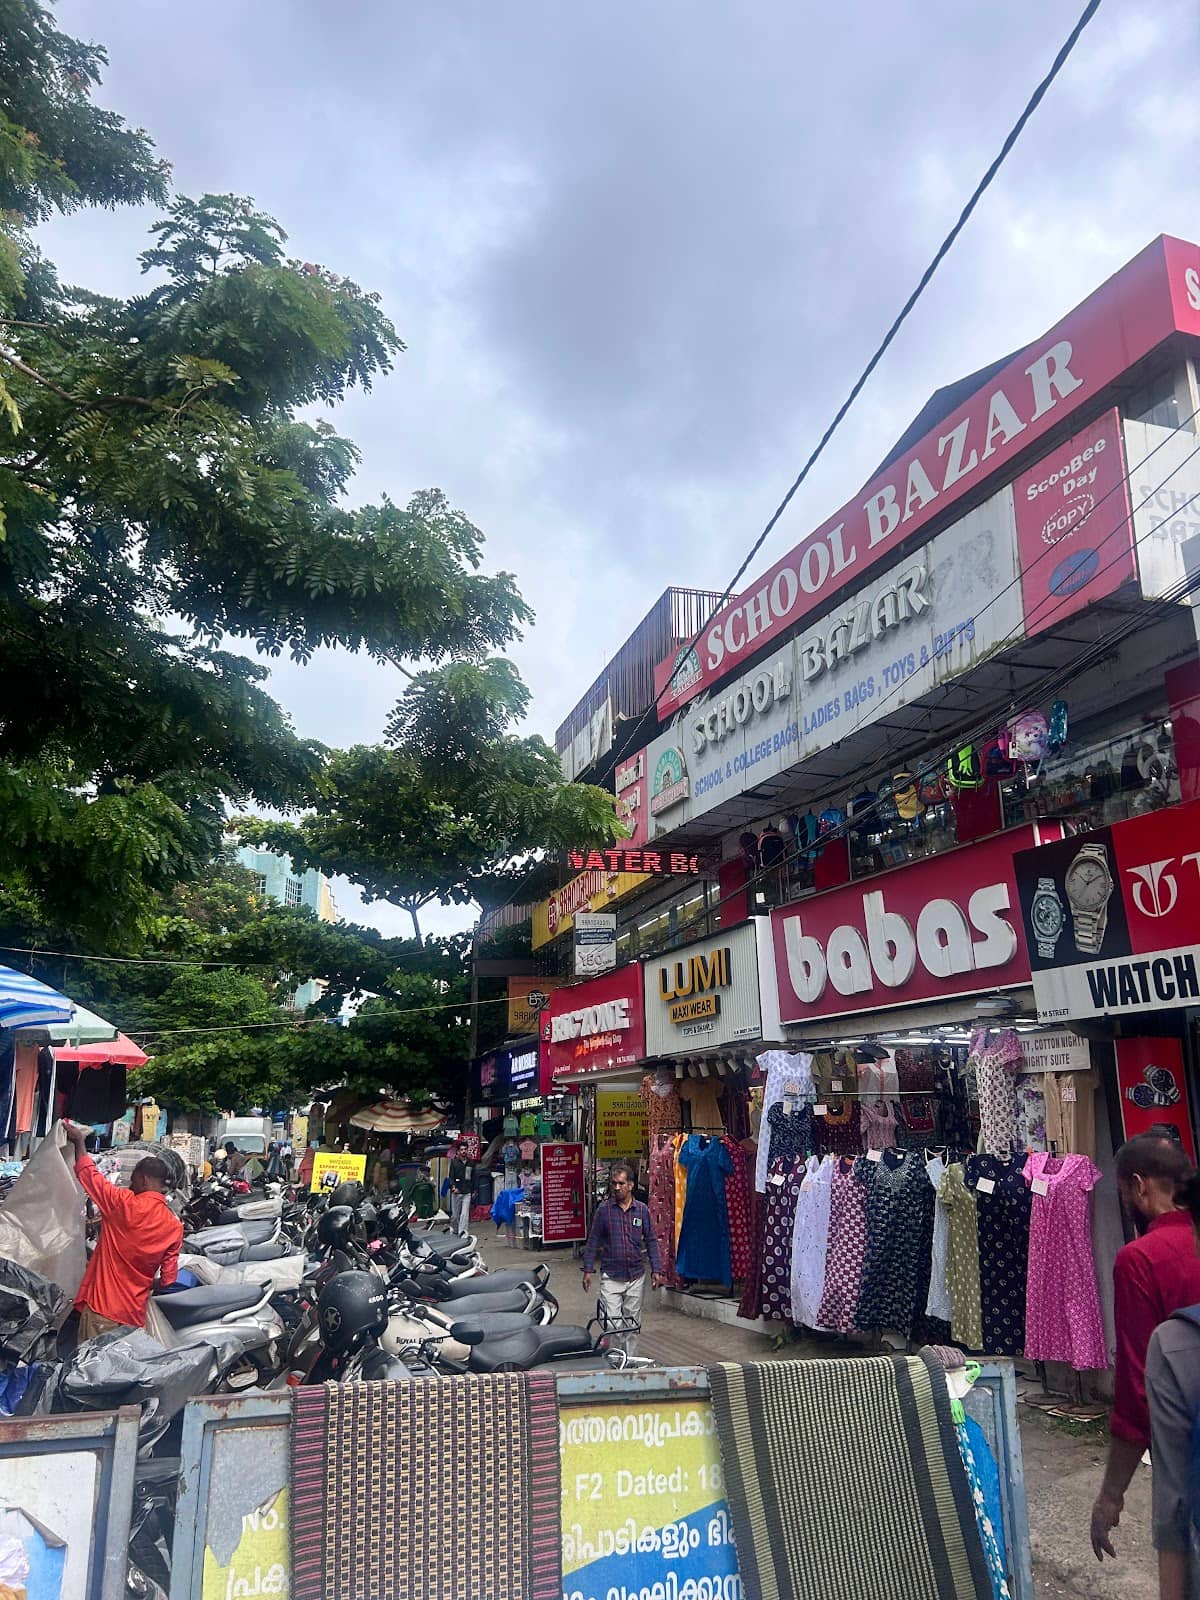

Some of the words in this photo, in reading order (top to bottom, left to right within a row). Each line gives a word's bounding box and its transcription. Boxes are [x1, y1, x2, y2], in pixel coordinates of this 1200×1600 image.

[1026, 438, 1107, 501] ScooBee
[1063, 466, 1098, 497] Day
[706, 527, 857, 672] SCHOOL
[863, 340, 1084, 550] BAZAR
[1046, 501, 1088, 538] POPY
[692, 661, 792, 755] SCHOOL
[801, 565, 933, 682] BAZAR
[694, 768, 724, 798] SCHOOL
[726, 762, 733, 778] &
[733, 738, 773, 771] COLLEGE
[804, 700, 842, 736] LADIES
[882, 653, 916, 690] TOYS
[919, 645, 930, 669] &
[934, 616, 977, 660] GIFTS
[783, 882, 1018, 1005] babas
[659, 946, 732, 1002] LUMI
[1086, 953, 1200, 1009] WATCH
[672, 1003, 688, 1020] MAXI
[690, 1000, 712, 1015] WEAR
[1035, 1037, 1060, 1051] COTTON
[1061, 1034, 1085, 1049] NIGHTY
[1050, 1053, 1070, 1066] SUITE
[396, 1336, 416, 1345] ROYAL
[576, 1472, 602, 1501] F2
[617, 1465, 689, 1498] Dated:
